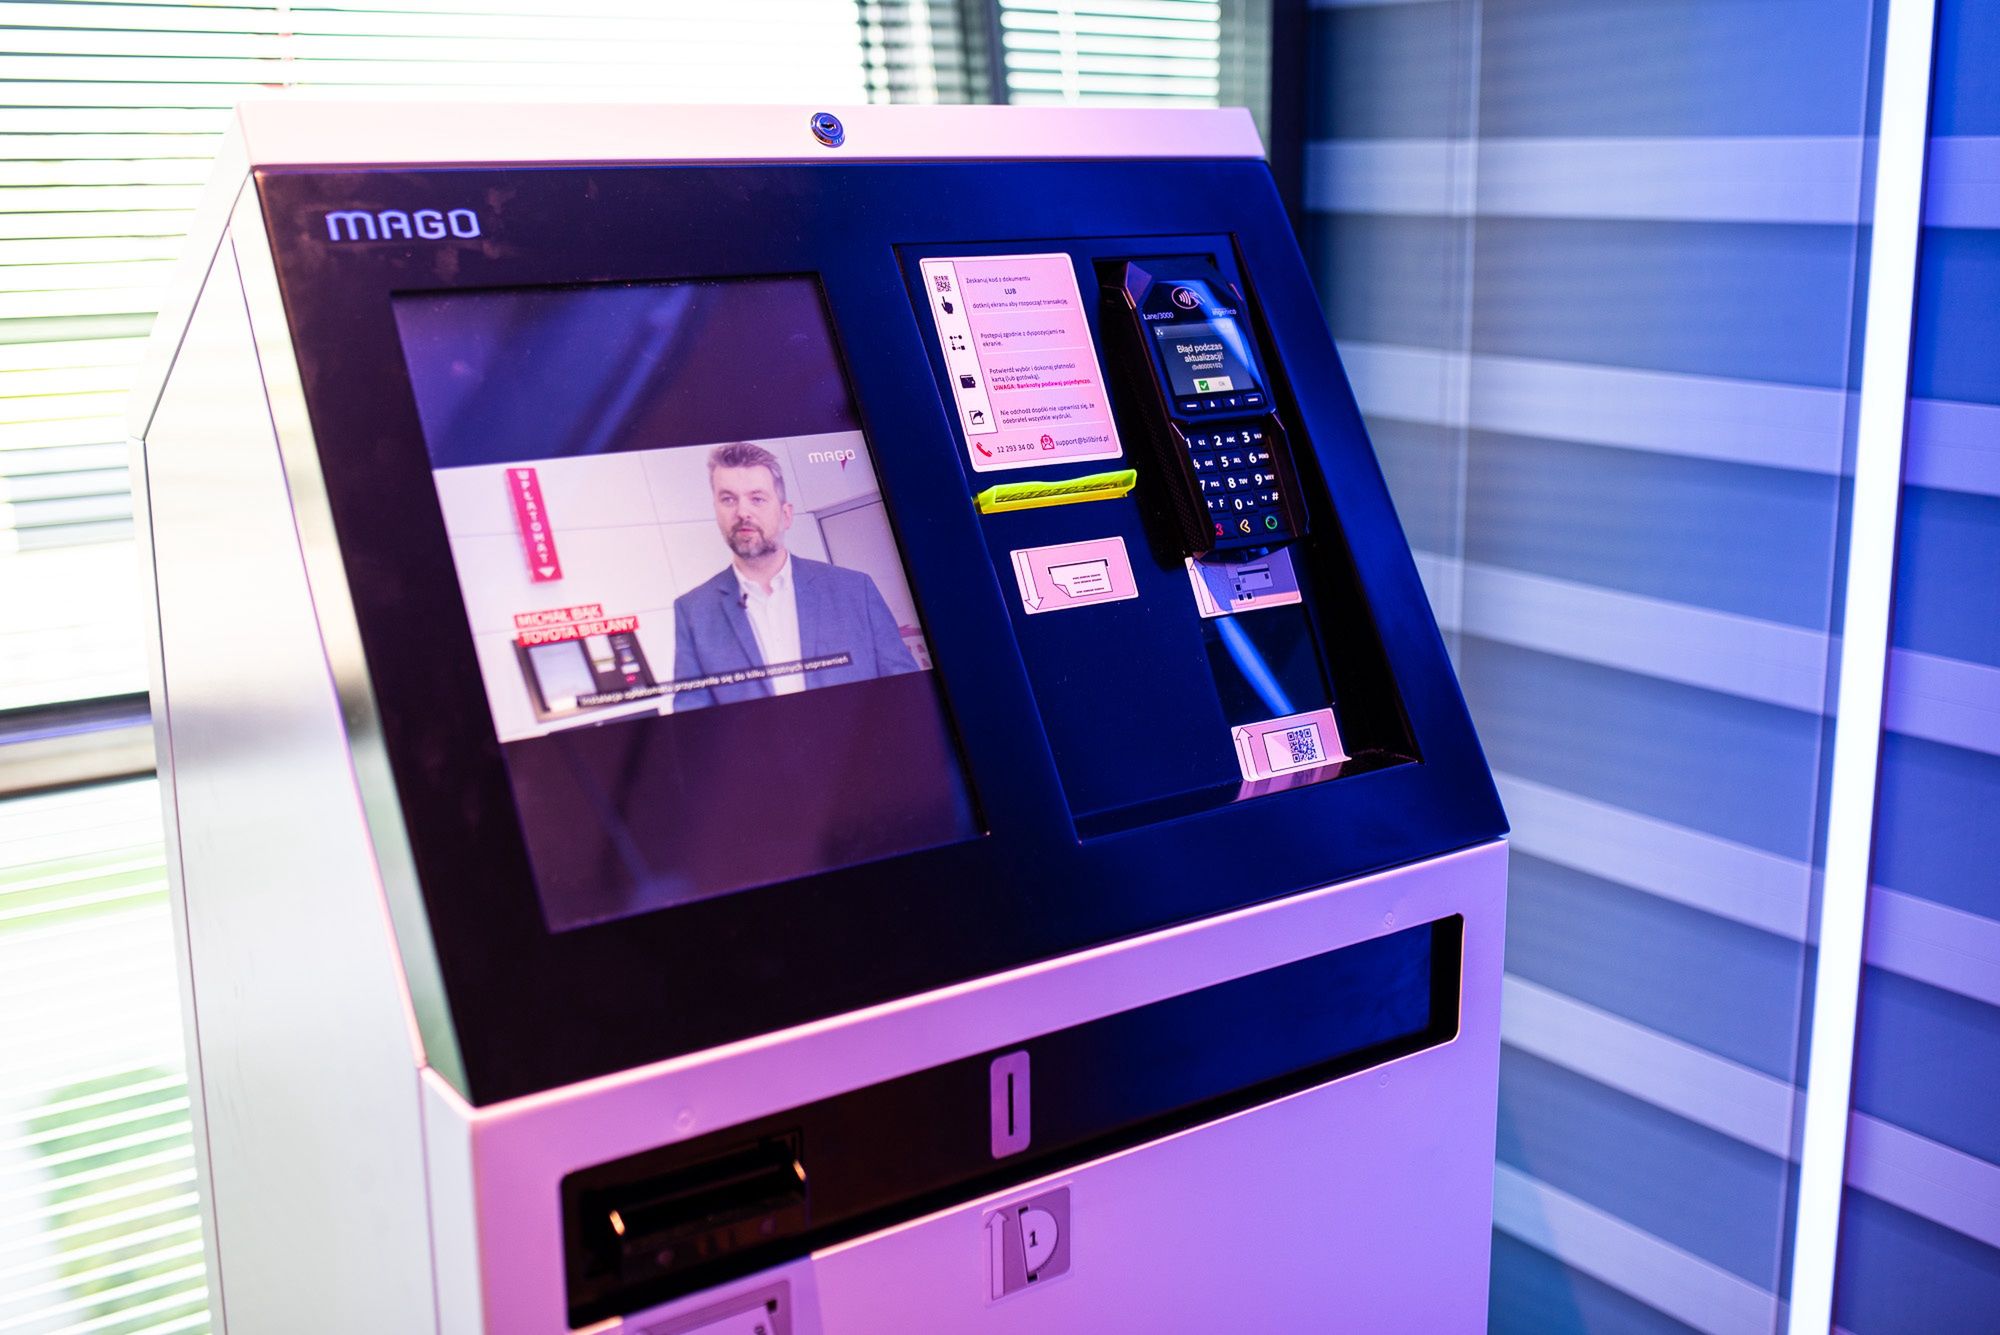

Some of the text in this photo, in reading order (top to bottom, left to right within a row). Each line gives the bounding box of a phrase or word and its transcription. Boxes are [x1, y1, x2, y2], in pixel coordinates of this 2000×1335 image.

[325, 209, 481, 241] MAGO
[1027, 329, 1058, 337] dyspozycjami
[1176, 342, 1223, 354] Błąd podczas
[989, 366, 1014, 374] Potwierdź
[1015, 365, 1031, 373] wybór
[1041, 380, 1063, 388] podawaj
[1031, 406, 1048, 414] dopóki
[1002, 413, 1072, 424] odebrałeś wszystkie wydruki.
[1186, 437, 1192, 449] 1
[1213, 435, 1222, 447] 2
[1242, 431, 1251, 443] 3
[997, 445, 1005, 453] 12
[1006, 444, 1017, 452] 293
[1018, 443, 1025, 451] 34
[807, 449, 856, 464] MAGO
[1220, 456, 1229, 468] 5
[1248, 452, 1257, 464] 6
[1193, 458, 1200, 470] 4
[1227, 477, 1237, 489] 8
[1254, 473, 1263, 485] 9
[1200, 480, 1206, 491] 7
[1234, 498, 1243, 510] 0
[521, 617, 635, 645] TOYOTA BIELANY
[720, 674, 733, 684] się
[733, 672, 746, 681] do
[745, 669, 766, 679] kilku
[1029, 1230, 1039, 1248] 1
